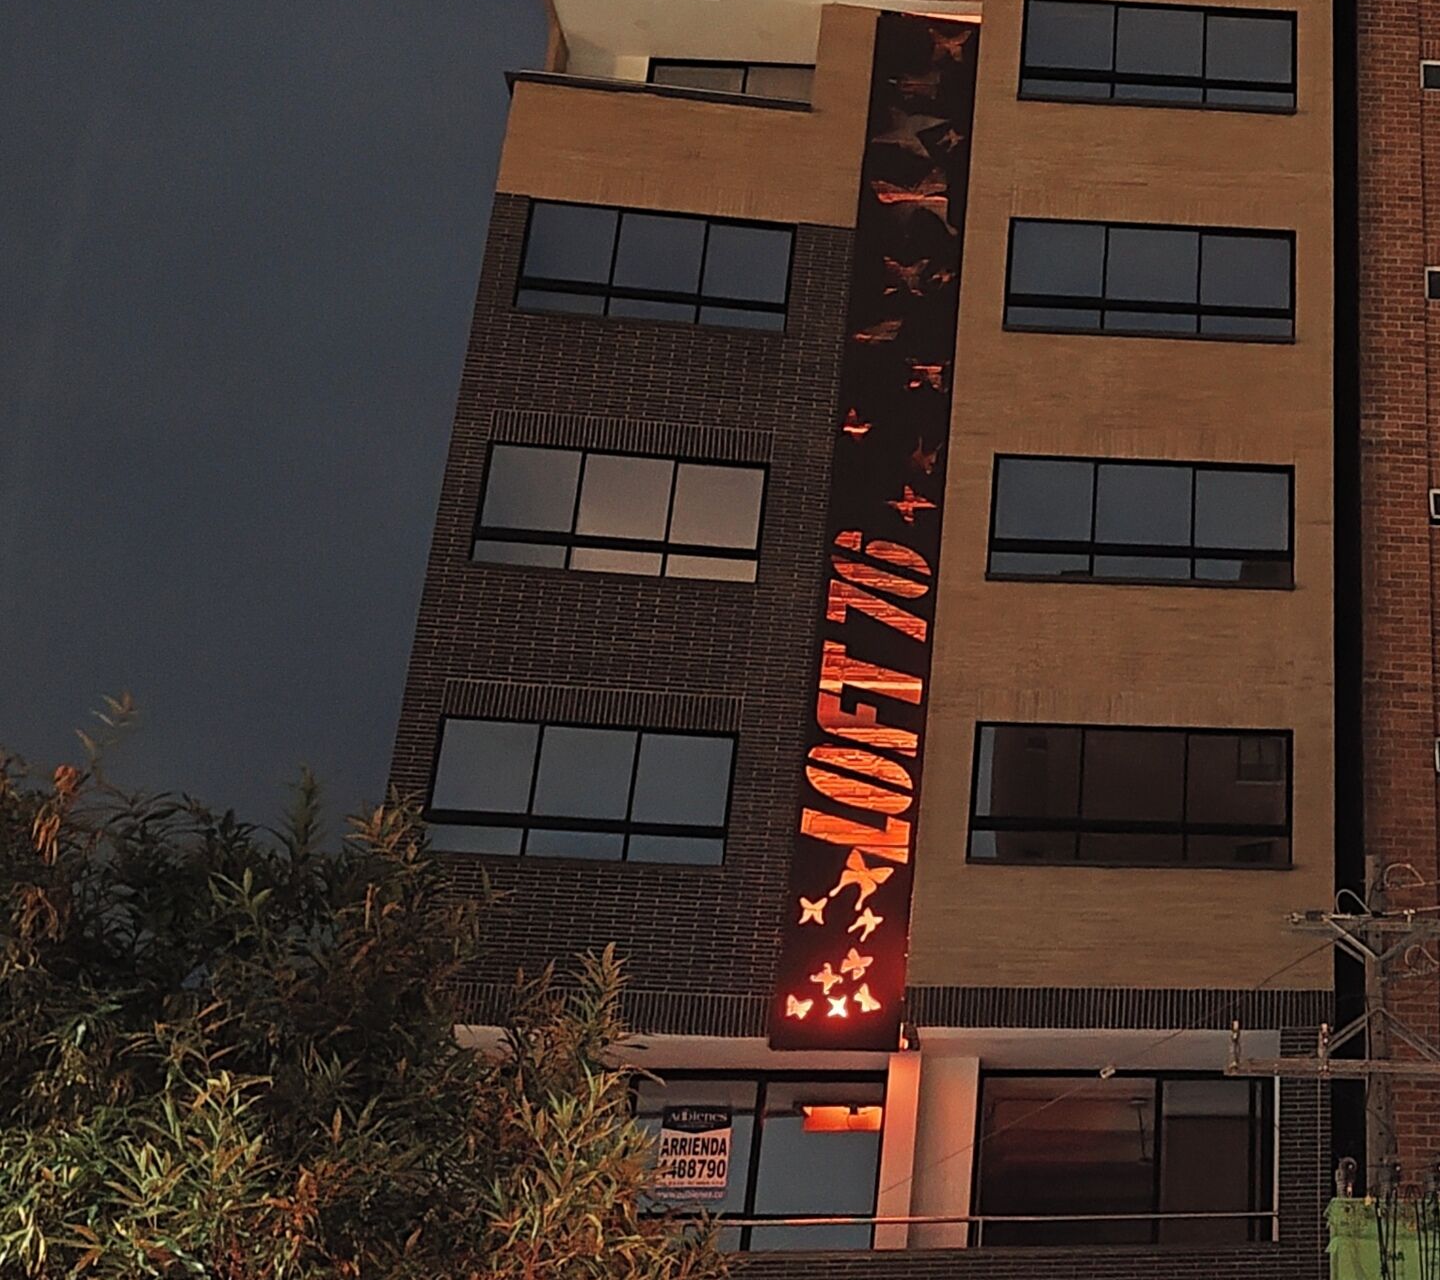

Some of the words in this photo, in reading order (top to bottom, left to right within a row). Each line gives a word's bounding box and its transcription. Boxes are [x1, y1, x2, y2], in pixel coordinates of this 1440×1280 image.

[827, 531, 932, 641] 76
[802, 641, 923, 864] LOFT
[661, 1138, 726, 1156] ARRIENDA
